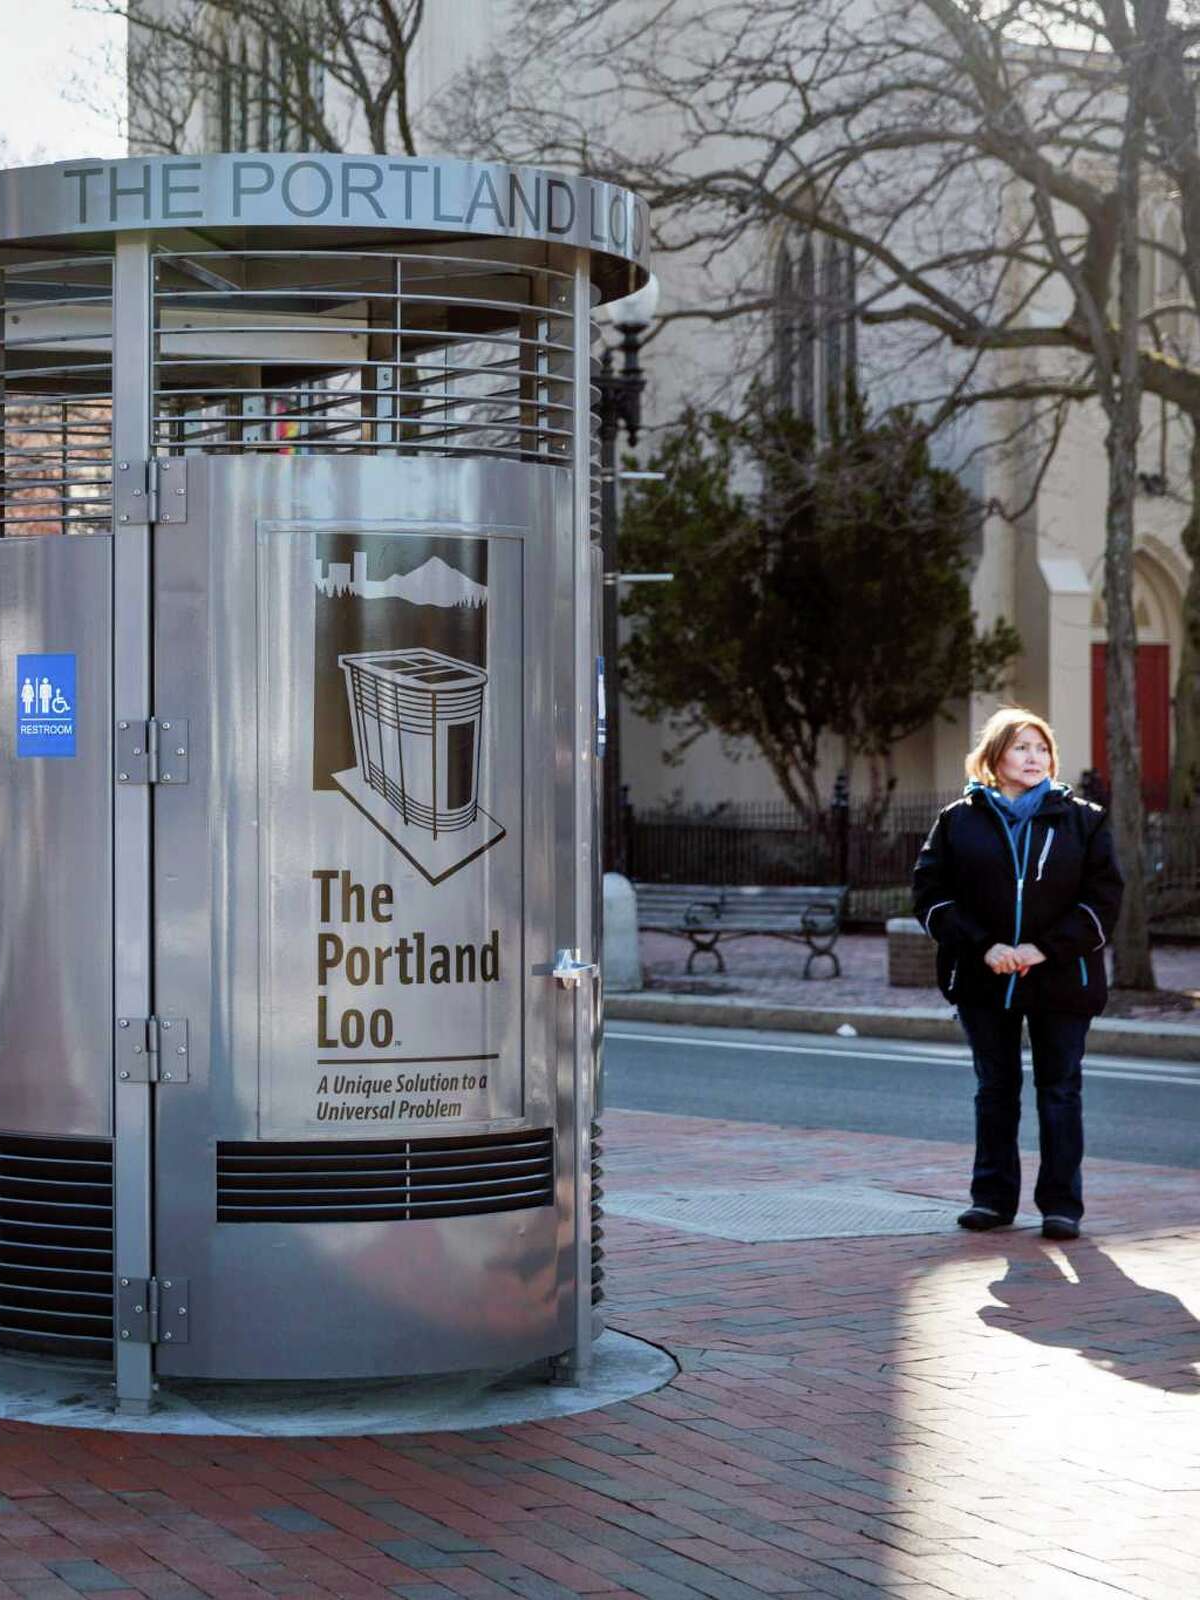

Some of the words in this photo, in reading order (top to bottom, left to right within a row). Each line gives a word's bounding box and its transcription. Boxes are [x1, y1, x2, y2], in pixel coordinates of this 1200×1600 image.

[64, 163, 203, 224] THE
[232, 161, 576, 235] PORTLAND
[20, 725, 73, 735] RESTROOM
[312, 870, 394, 923] The
[317, 930, 500, 986] Portland
[317, 996, 394, 1048] Loo
[317, 1075, 328, 1094] A
[334, 1074, 393, 1098] Unique
[396, 1073, 459, 1093] Solution
[462, 1074, 476, 1090] to
[479, 1074, 488, 1089] a
[317, 1100, 396, 1121] Universal
[398, 1099, 462, 1119] Problem
